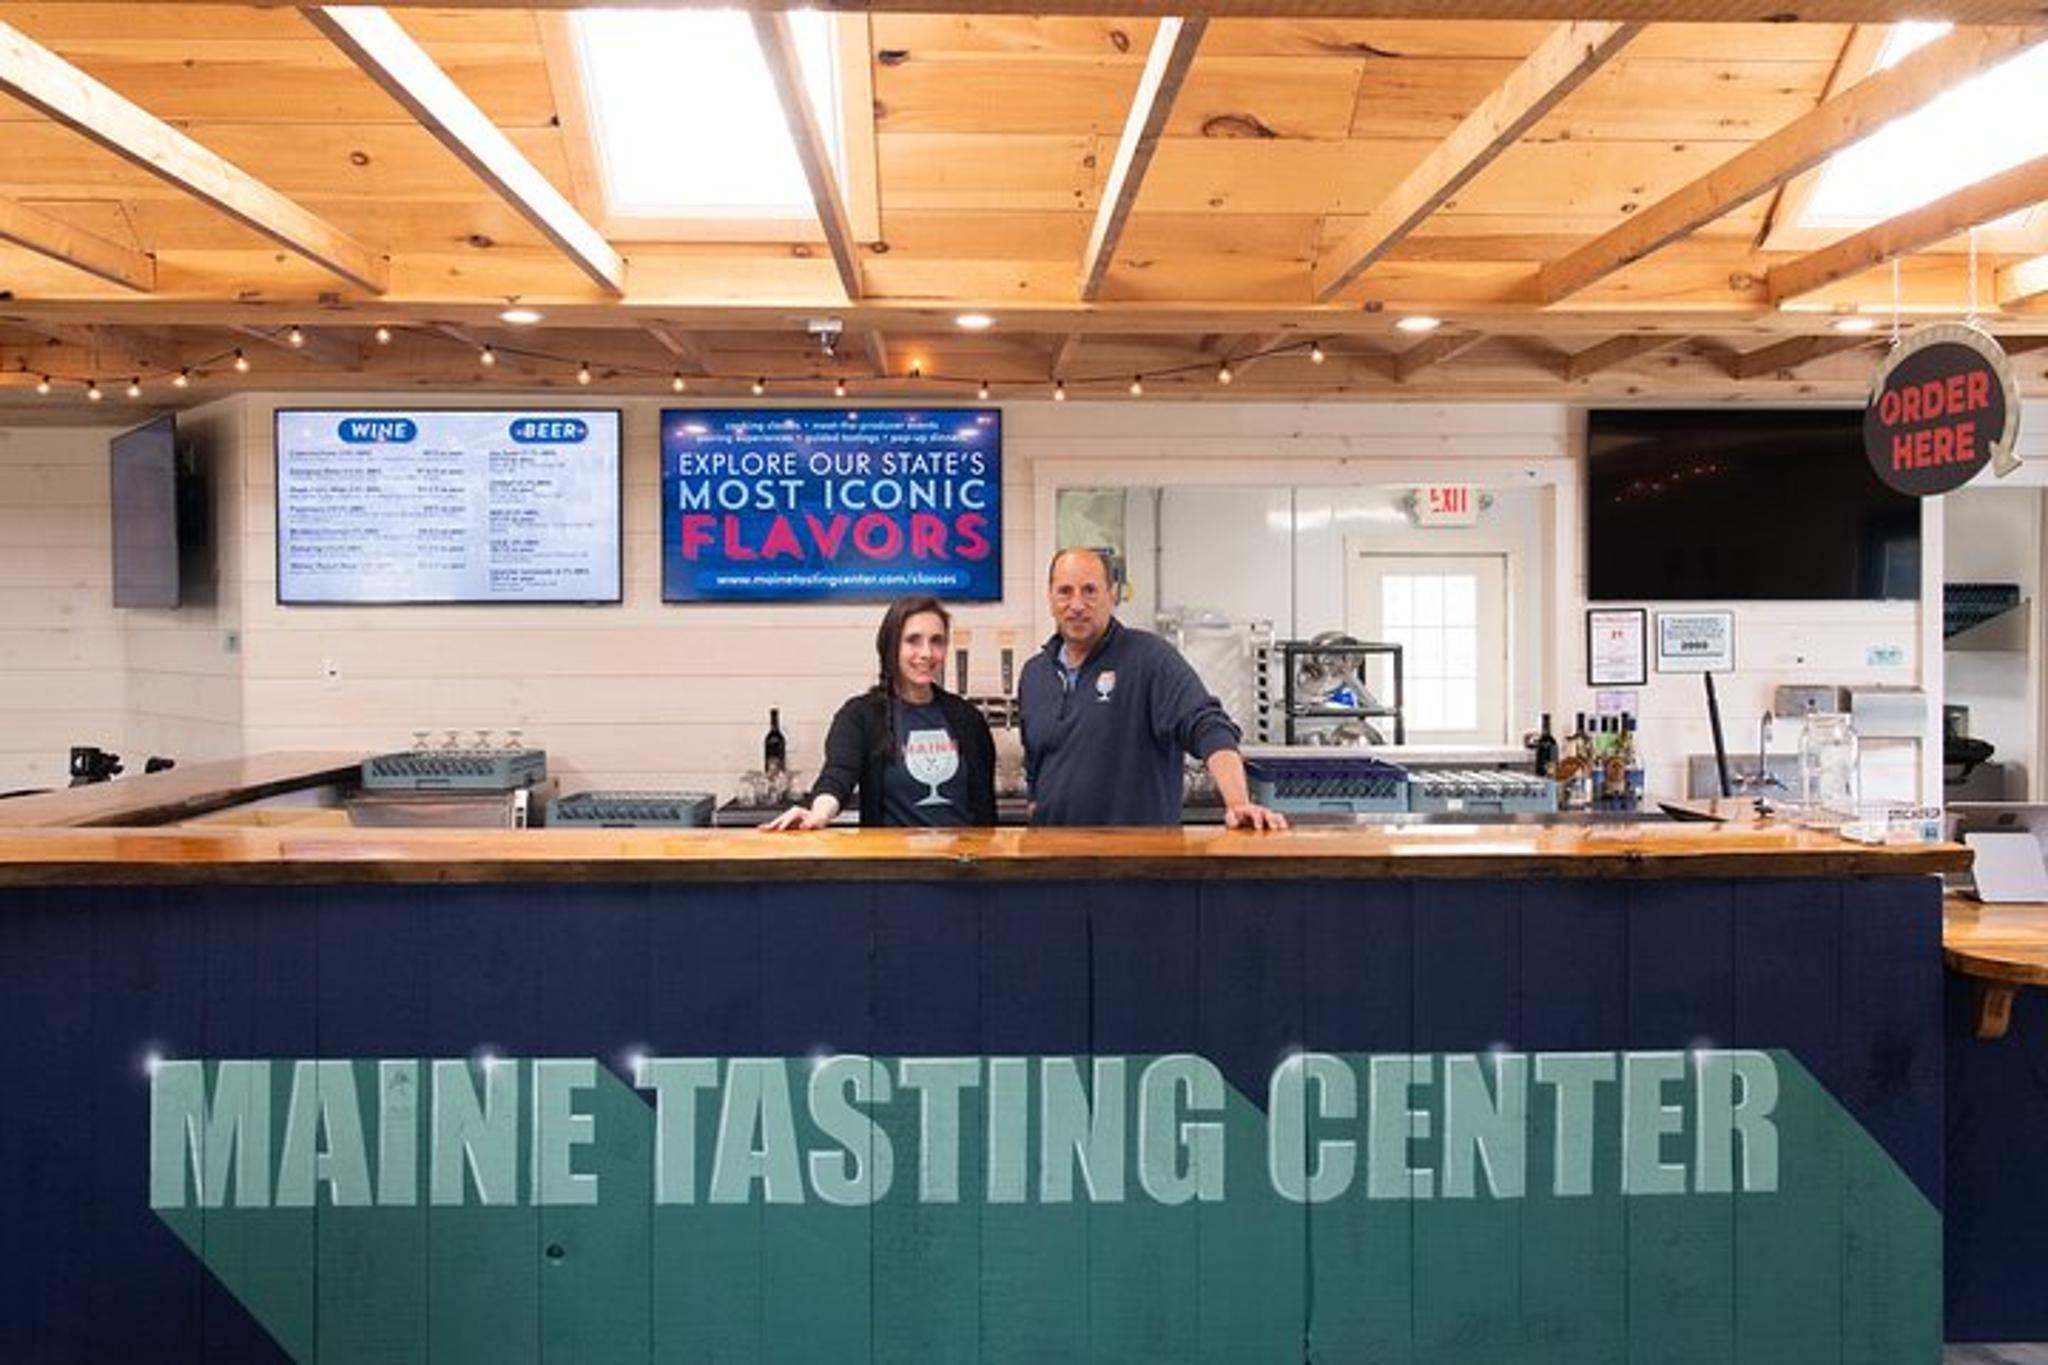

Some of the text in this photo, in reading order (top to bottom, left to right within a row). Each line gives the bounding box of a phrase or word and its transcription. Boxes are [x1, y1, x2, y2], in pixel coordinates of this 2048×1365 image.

[1879, 370, 1989, 426] ORDER
[351, 422, 408, 439] WINE
[524, 422, 577, 439] BEER
[1892, 420, 1975, 471] HERE
[679, 452, 798, 476] EXPLORE
[808, 452, 871, 476] OUR
[679, 479, 986, 510] MOST ICONIC
[1429, 486, 1470, 513] EXIT
[682, 512, 991, 561] FLAVORS
[149, 1048, 1780, 1209] MAINE TASTING CENTER
